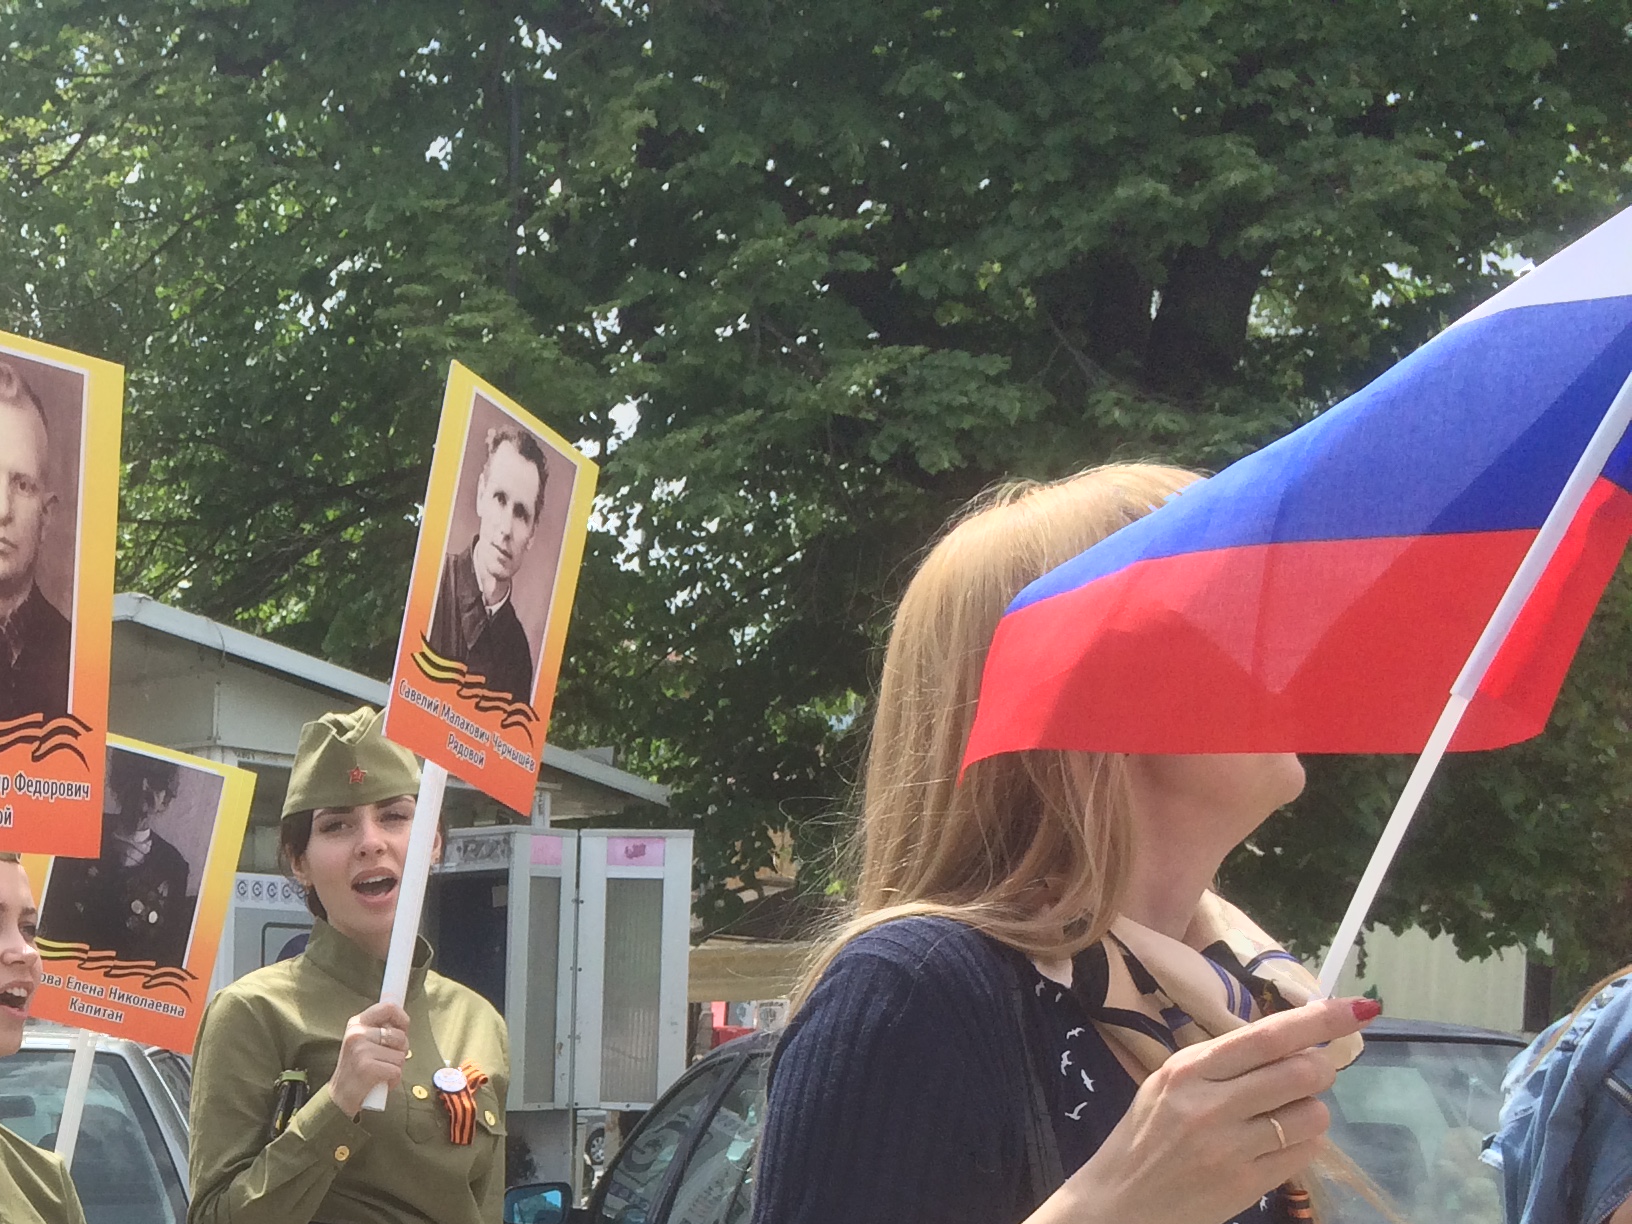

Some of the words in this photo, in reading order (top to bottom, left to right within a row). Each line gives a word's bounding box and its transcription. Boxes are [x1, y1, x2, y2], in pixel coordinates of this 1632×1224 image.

[399, 679, 440, 714] Савелий
[441, 703, 490, 743] Малахович
[448, 733, 485, 766] Рядовой
[15, 773, 89, 800] Федорович
[66, 976, 104, 997] Елена
[109, 987, 185, 1017] Николаевна
[69, 997, 123, 1022] Капитан
